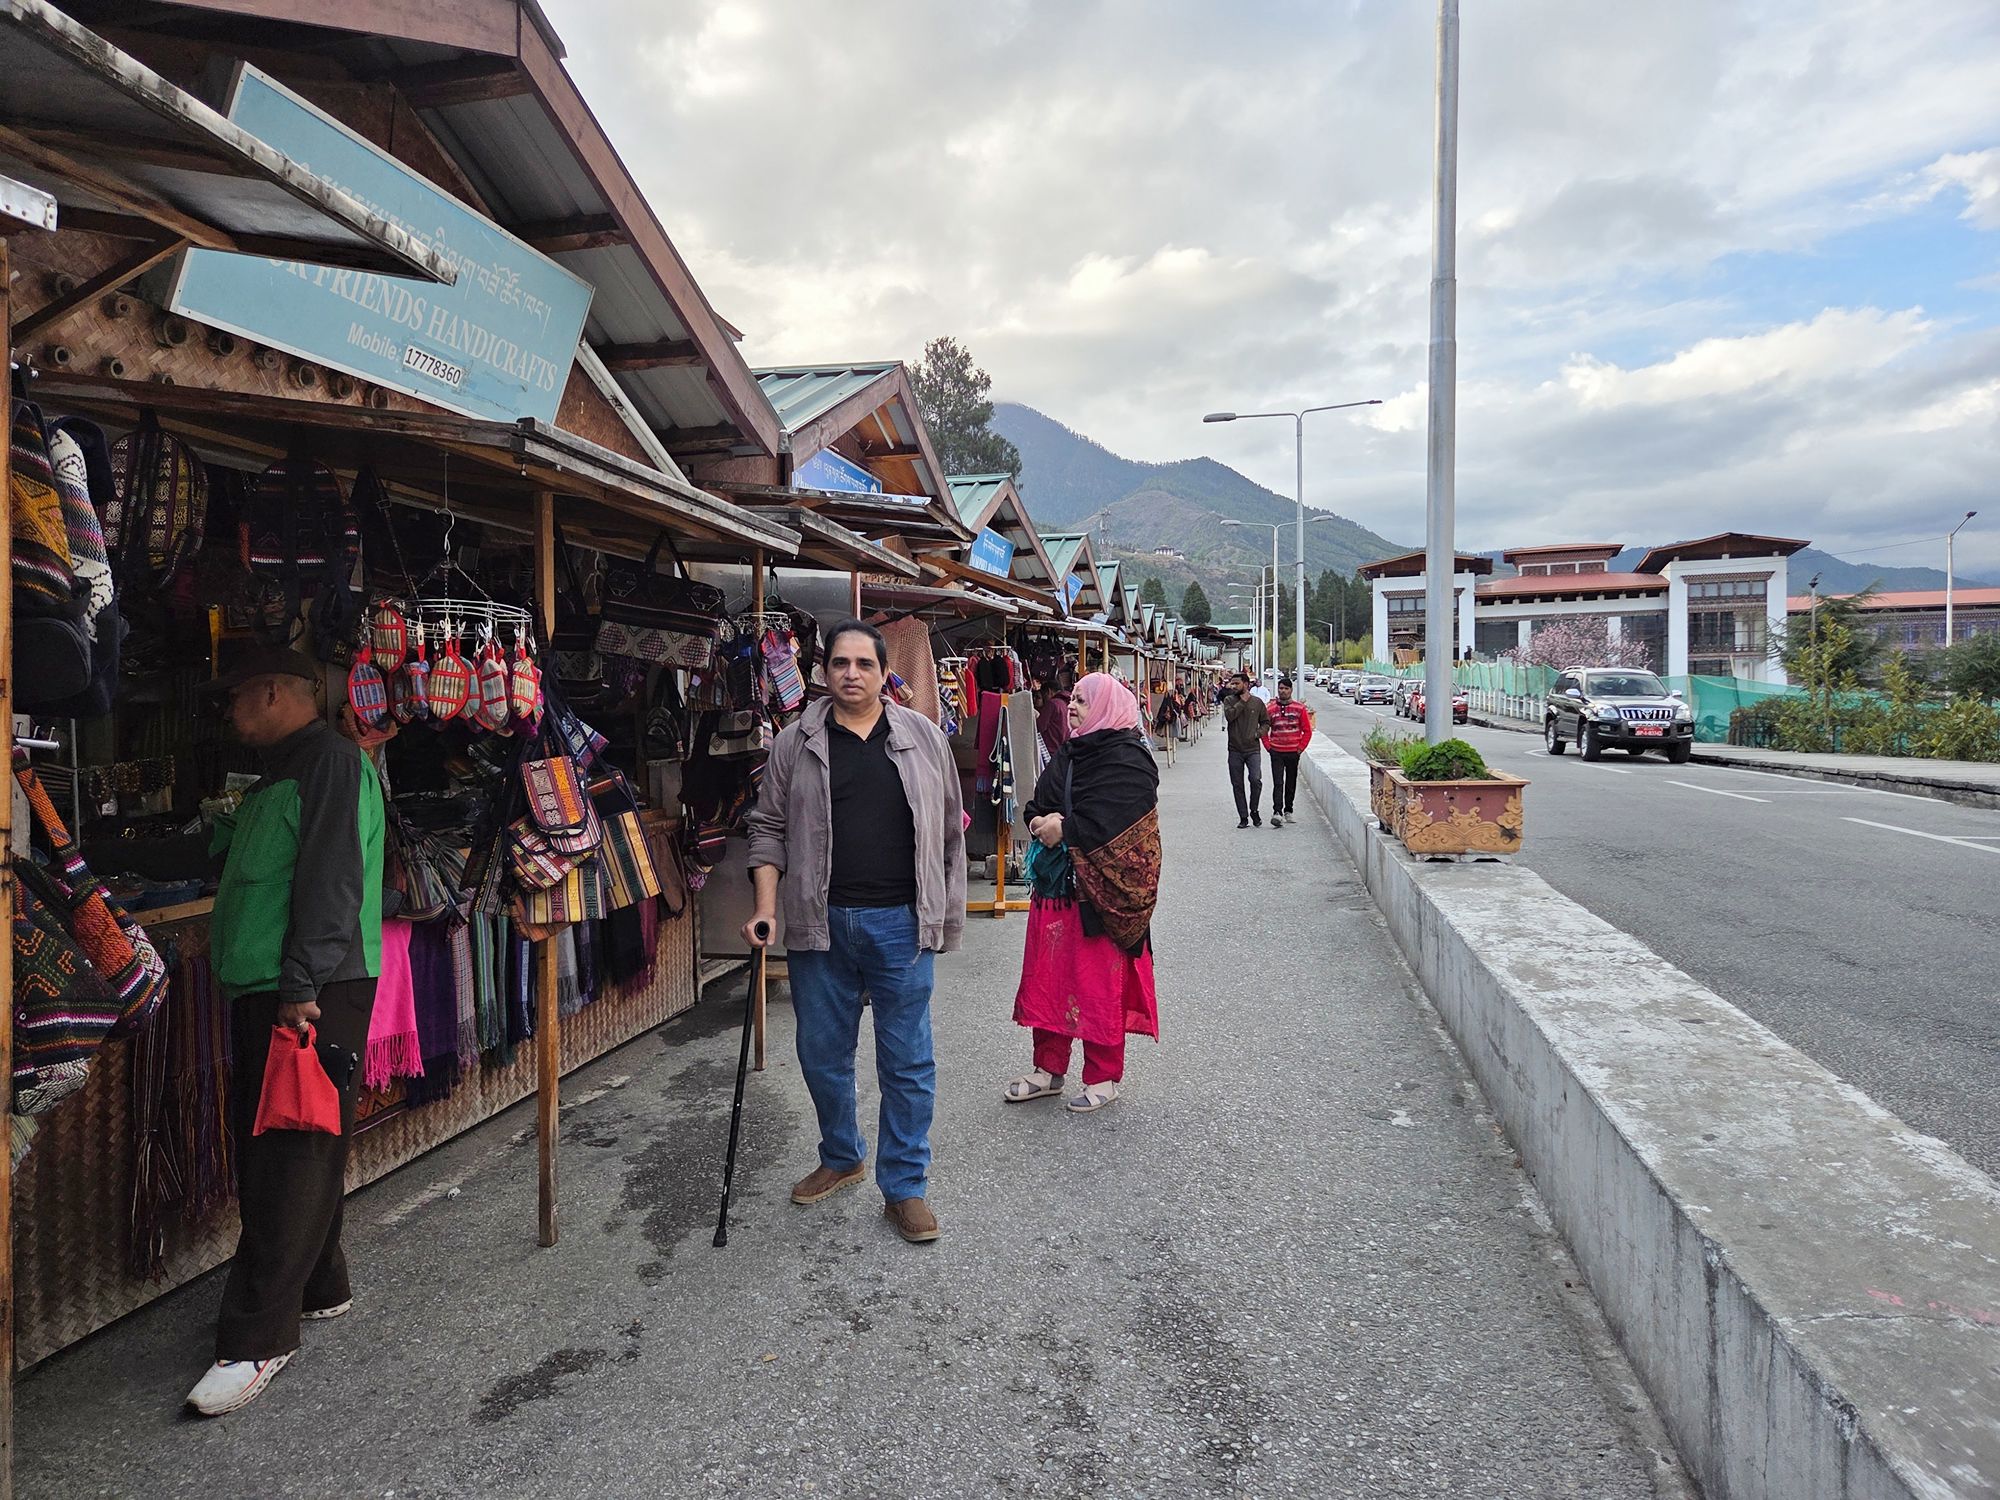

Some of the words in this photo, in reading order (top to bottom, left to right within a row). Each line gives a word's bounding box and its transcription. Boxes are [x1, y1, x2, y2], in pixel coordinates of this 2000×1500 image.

[313, 266, 427, 331] FRIENDS
[425, 305, 558, 392] HANDICRAFTS
[347, 322, 402, 363] Mobile:
[404, 347, 461, 385] 17778360
